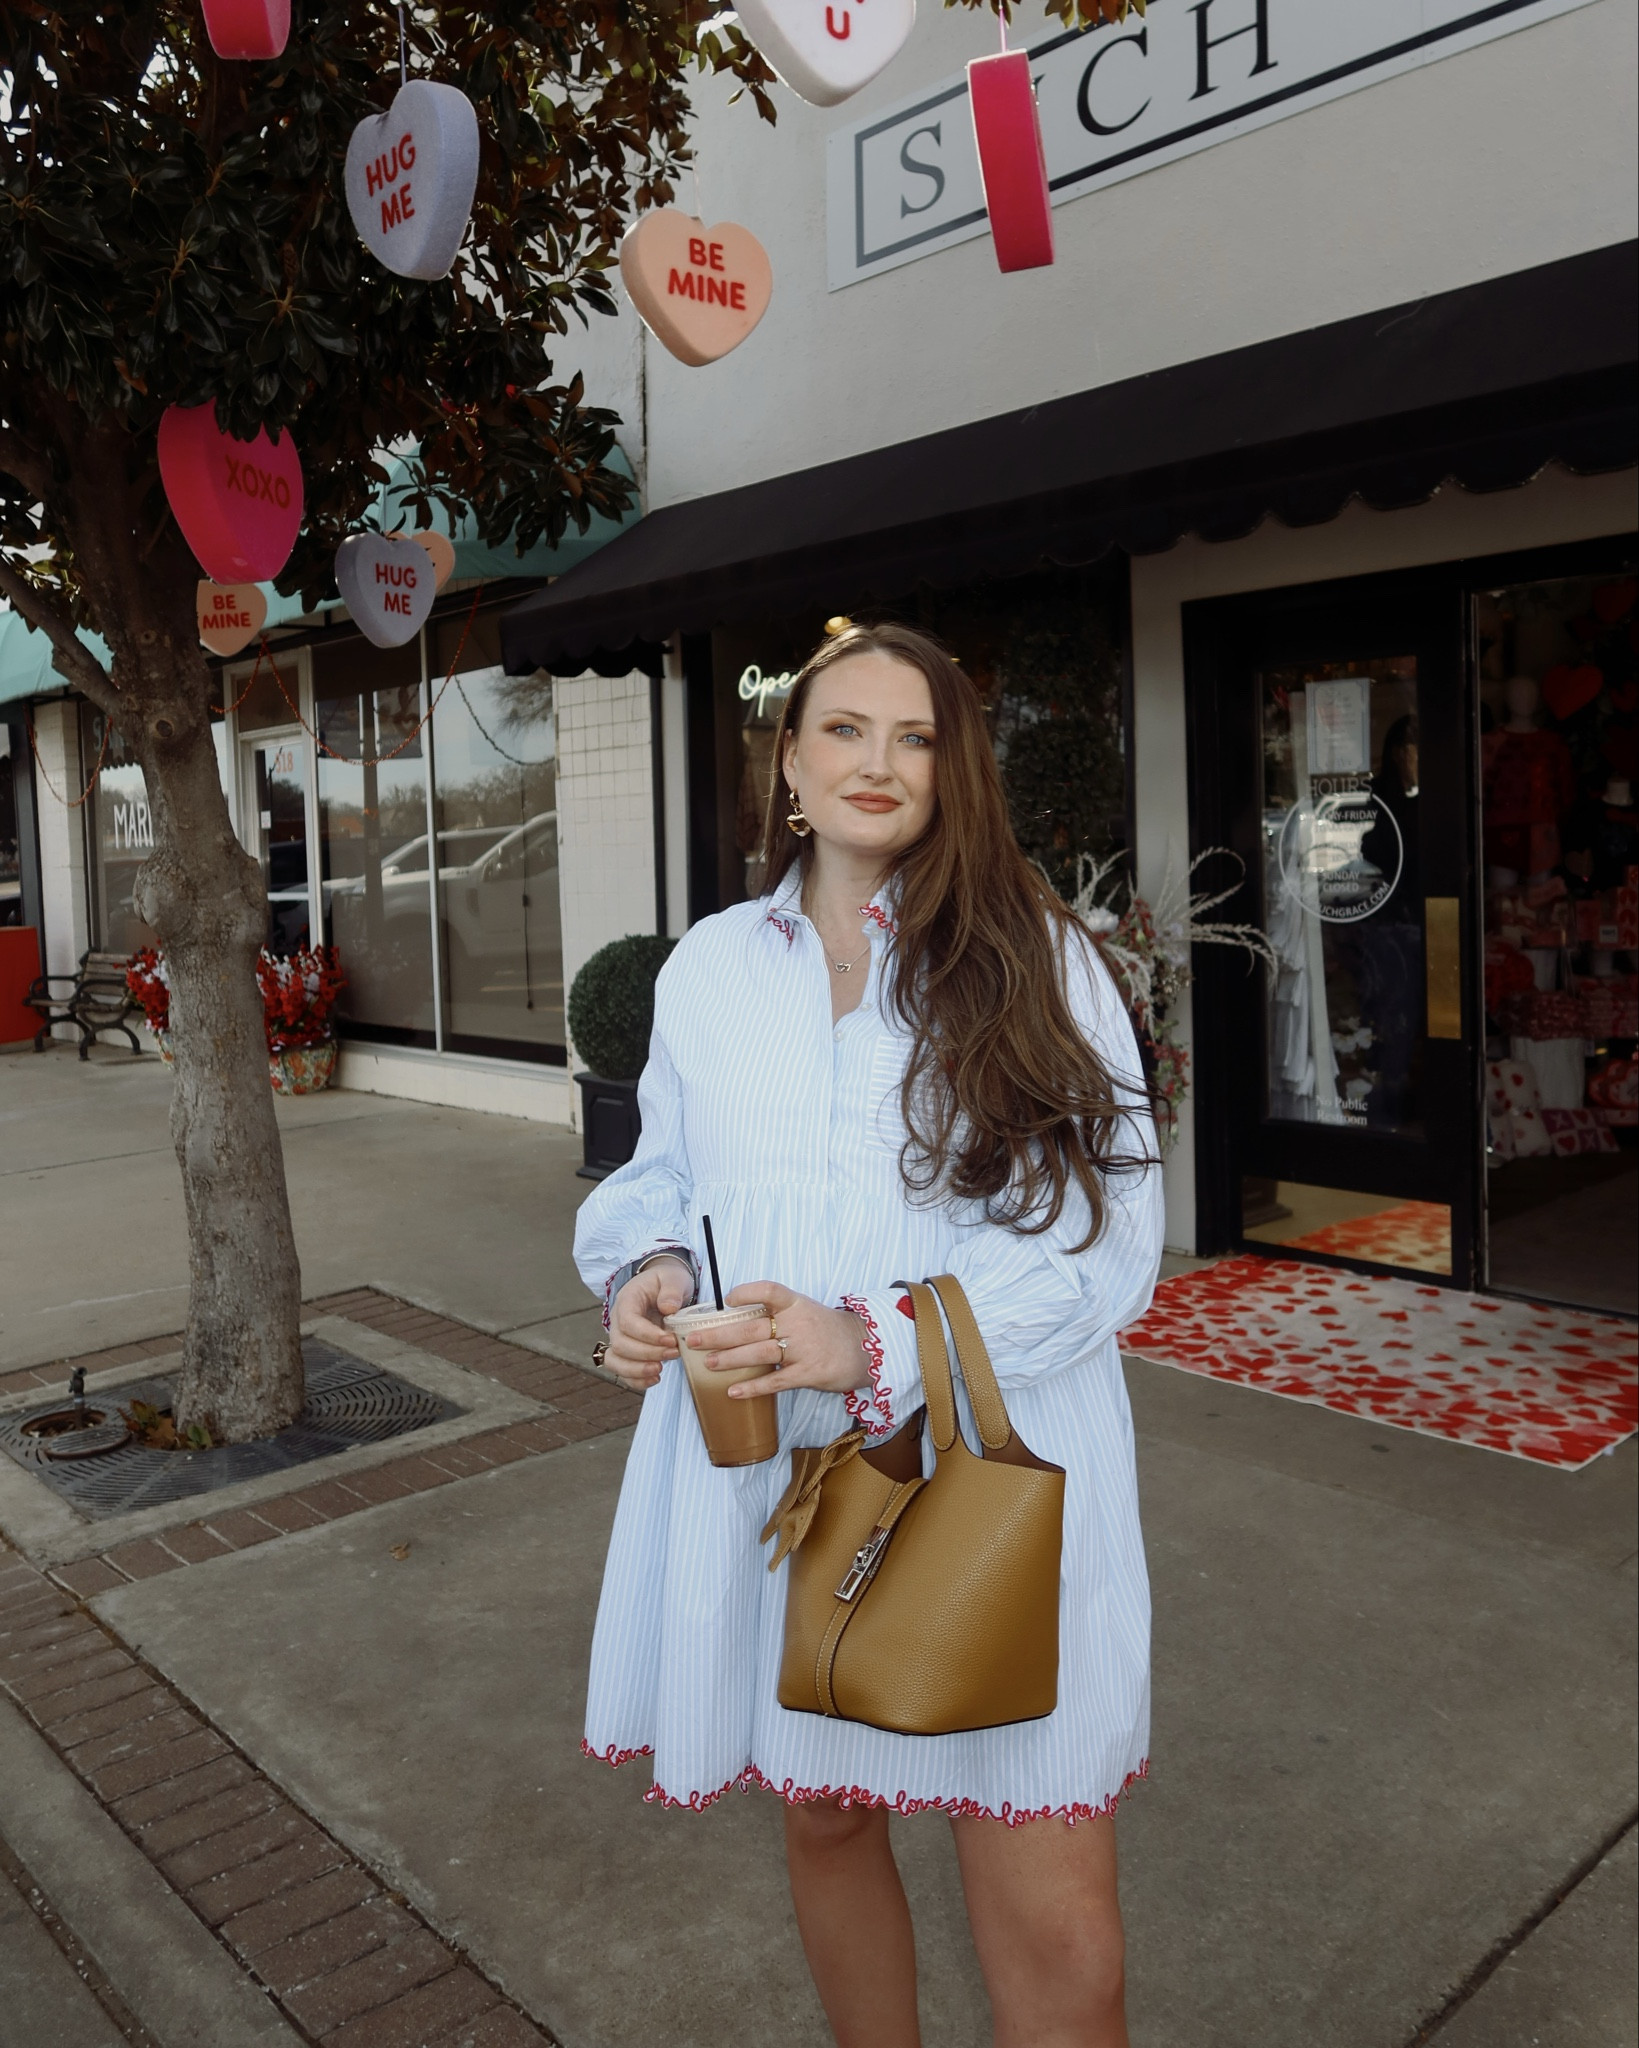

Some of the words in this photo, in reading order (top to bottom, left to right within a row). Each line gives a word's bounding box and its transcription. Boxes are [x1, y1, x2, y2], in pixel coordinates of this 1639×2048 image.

[826, 5, 851, 41] U
[900, 0, 1279, 219] SCH
[366, 134, 416, 196] HUG
[381, 191, 415, 234] ME
[688, 236, 726, 272] BE
[667, 266, 748, 312] MINE
[225, 453, 290, 509] XOXO
[375, 563, 417, 590] HUG
[202, 611, 251, 630] MINE
[213, 594, 236, 611] BE
[384, 592, 411, 617] ME
[738, 664, 803, 718] Ope
[1308, 777, 1373, 797] HOURS
[1322, 871, 1360, 882] SUNDAY
[1322, 884, 1360, 894] CLOSED
[1319, 881, 1391, 918] UCHGRACE.COM
[1335, 1096, 1368, 1111] Public
